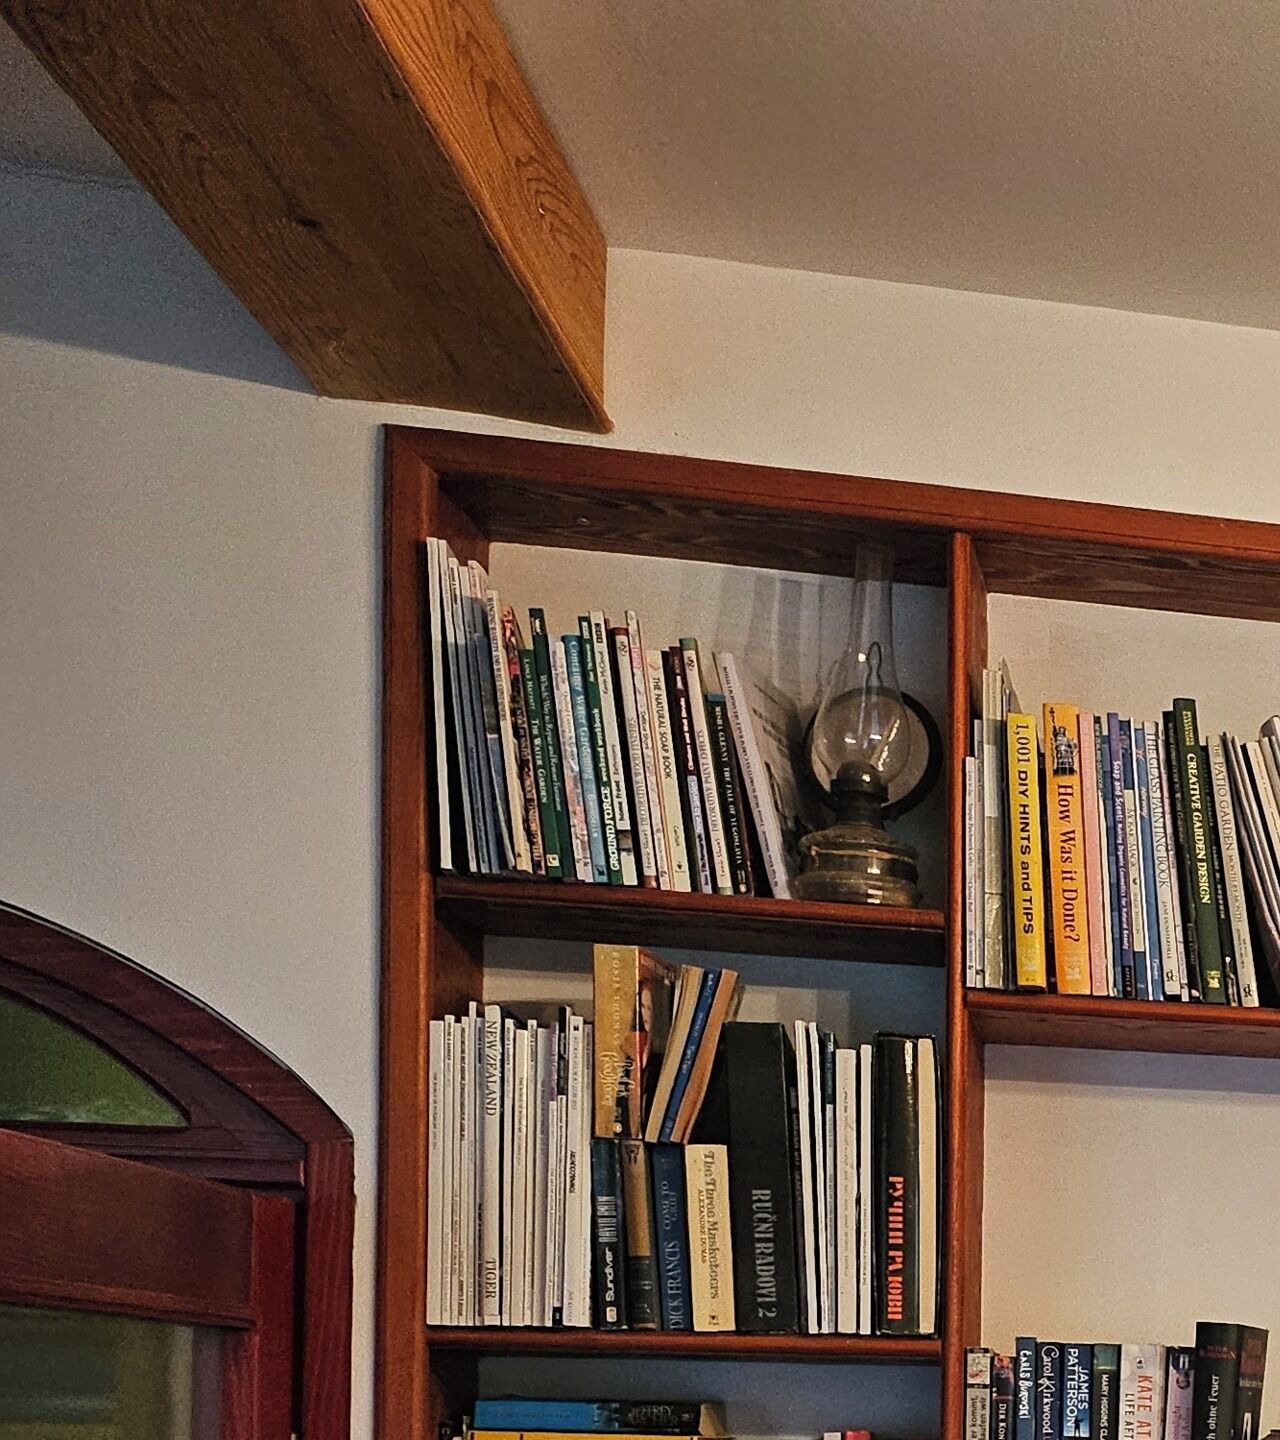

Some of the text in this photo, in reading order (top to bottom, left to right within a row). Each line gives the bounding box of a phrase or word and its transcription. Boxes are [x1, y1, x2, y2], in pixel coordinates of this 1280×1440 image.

[652, 677, 672, 779] THE NATURAL SOAP BOOK
[1186, 753, 1201, 809] CREATIVE
[1015, 723, 1034, 934] 1,001 DIY HINTS and TIPS
[1191, 811, 1206, 859] GARDEN
[1057, 784, 1080, 942] How Was it Done?
[1196, 862, 1210, 904] DESIGN
[485, 1020, 497, 1117] NEW ZEALAND
[703, 1151, 719, 1300] The Three Musketeers
[604, 1247, 615, 1301] Sundiver
[751, 1190, 776, 1318] RUČNI RADOVI 2
[485, 1258, 497, 1299] TIGER
[665, 1241, 684, 1329] DICK FRANCIS
[978, 1396, 987, 1409] wir
[1038, 1346, 1059, 1433] Carol Kirkwood
[1066, 1349, 1078, 1426] PATTERSON
[1079, 1366, 1089, 1409] JAMES
[1100, 1375, 1109, 1396] MARY
[1125, 1393, 1134, 1416] LIFE
[1137, 1375, 1152, 1412] KATE
[1208, 1375, 1220, 1402] Feuer
[970, 1395, 980, 1428] kommt,
[977, 1412, 986, 1440] laufen
[1100, 1397, 1109, 1426] HIGGINS
[1207, 1405, 1217, 1429] ohne
[971, 1430, 978, 1439] er
